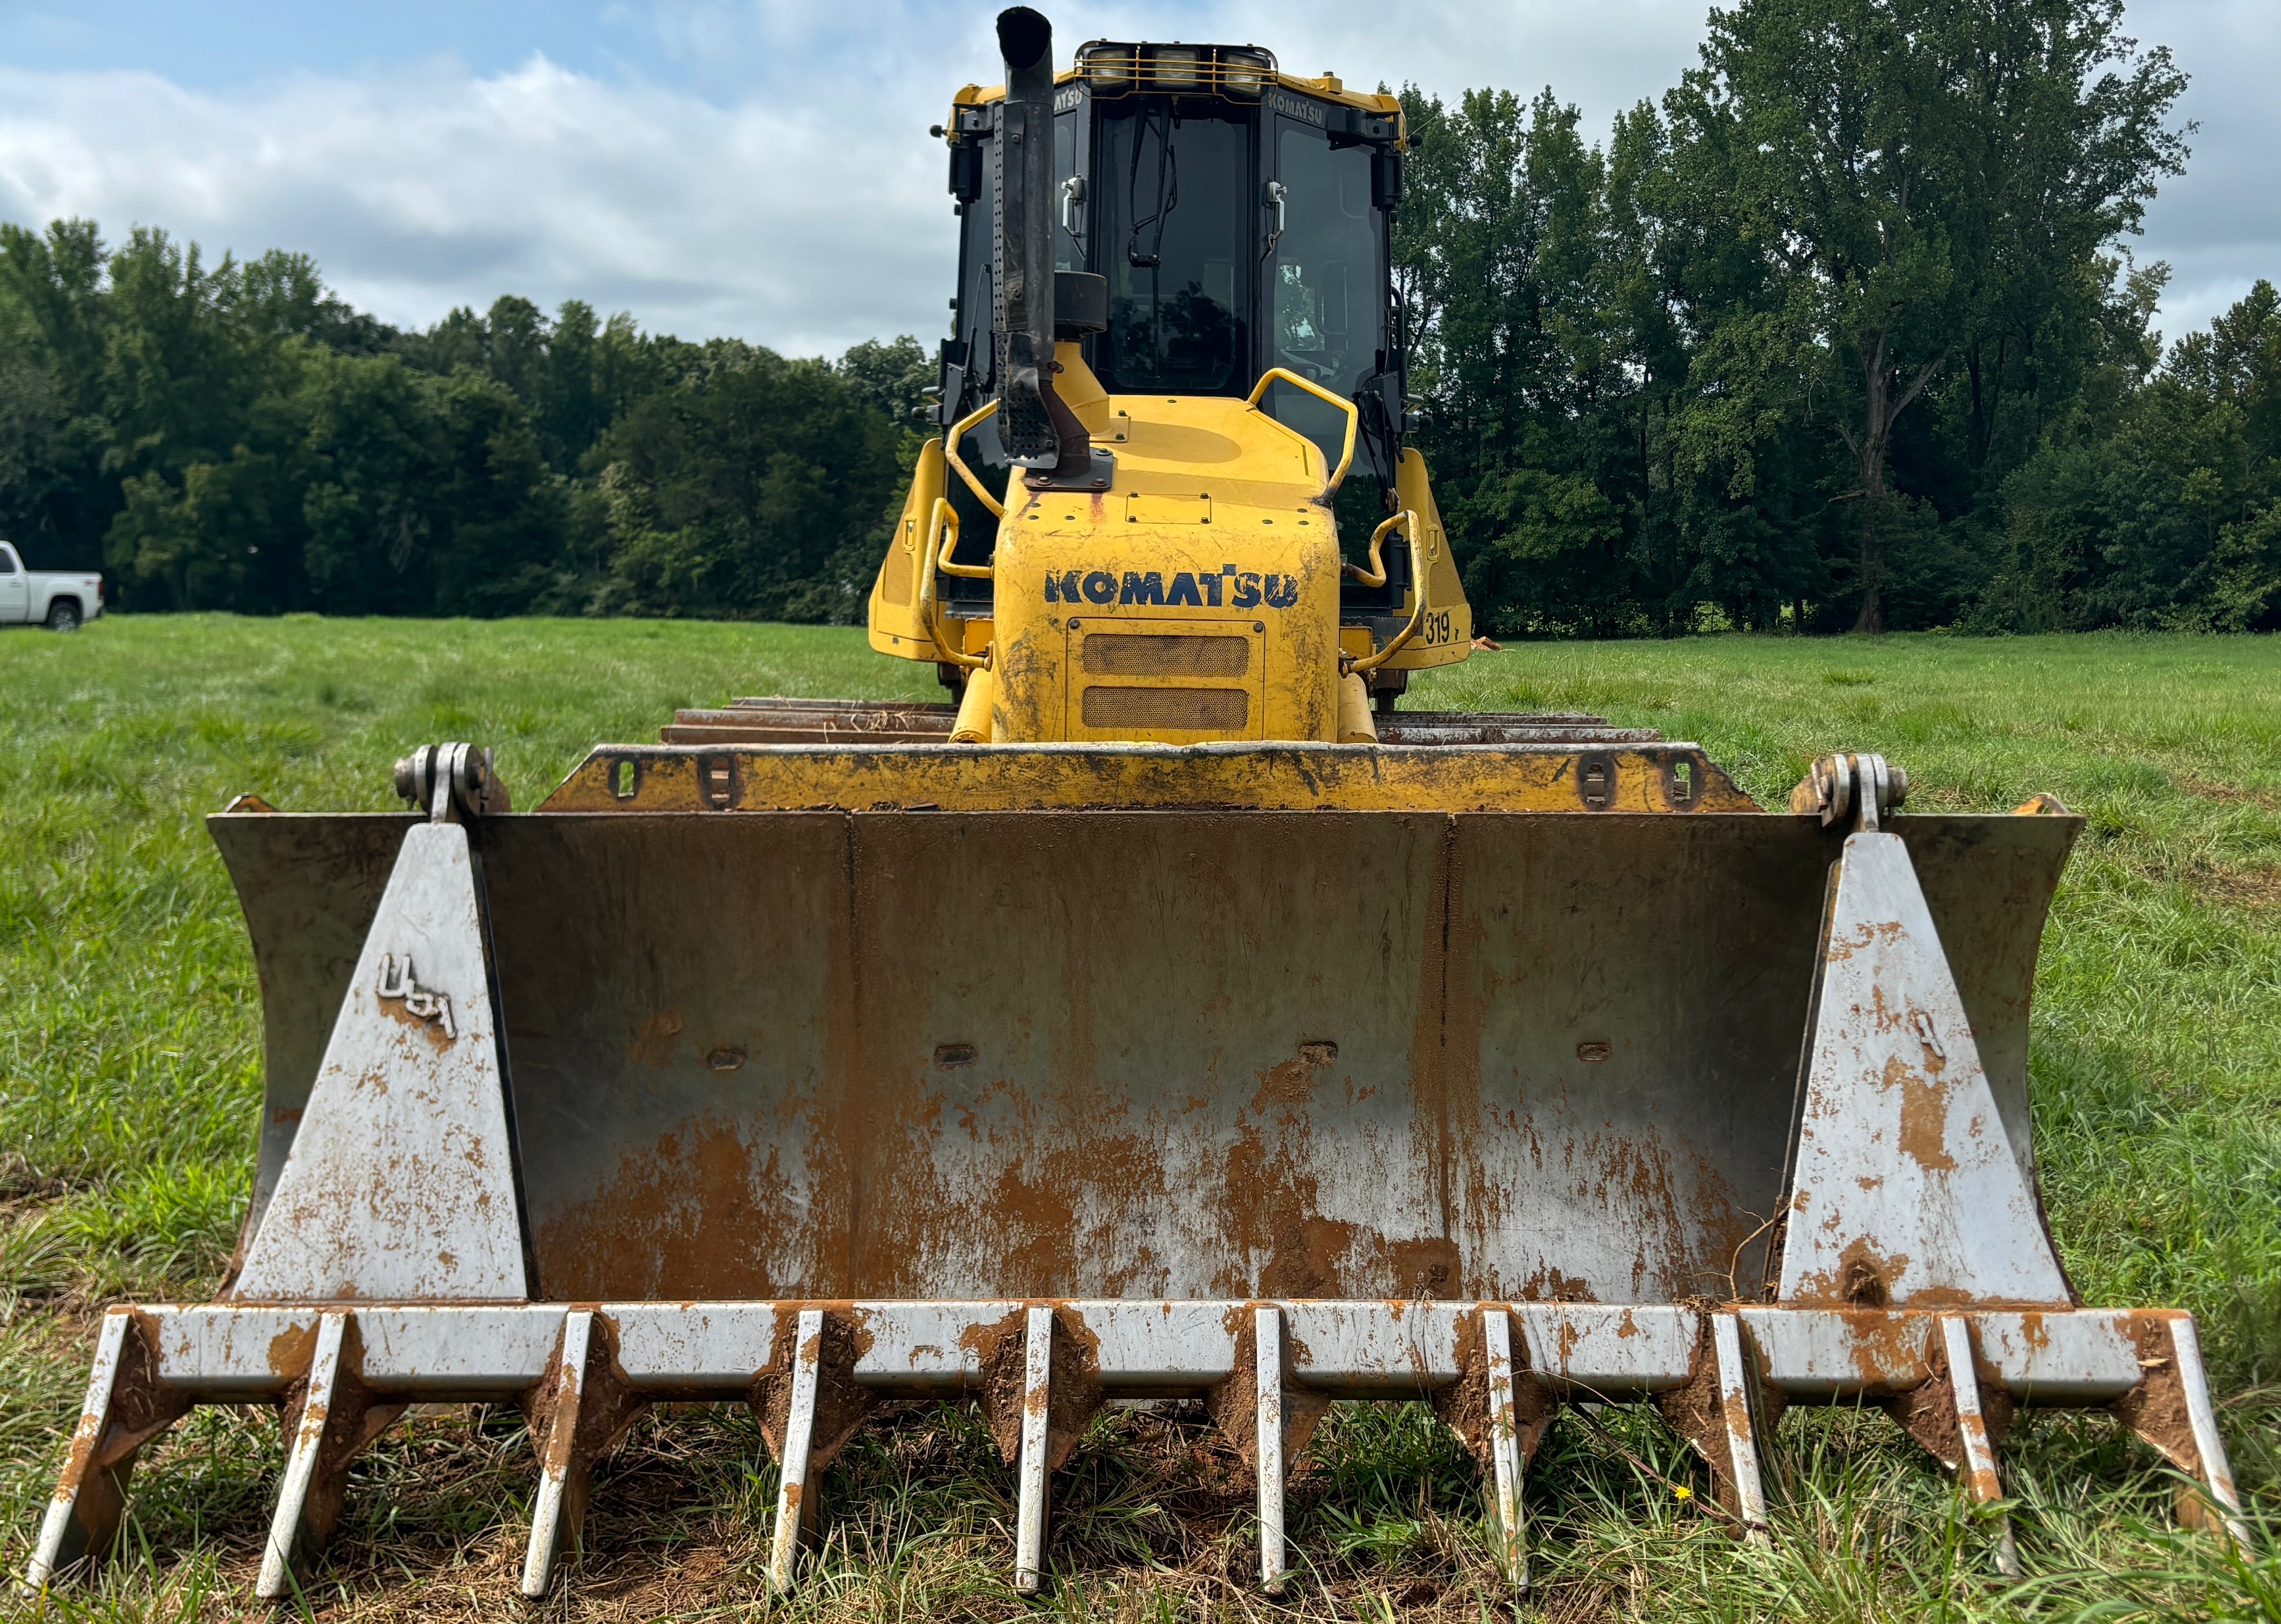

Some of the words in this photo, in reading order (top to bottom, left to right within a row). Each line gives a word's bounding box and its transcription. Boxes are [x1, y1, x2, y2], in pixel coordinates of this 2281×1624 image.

[1053, 88, 1083, 111] ATSU
[1268, 93, 1323, 124] KOMATSU
[1044, 564, 1298, 608] KOMATSU
[1425, 612, 1450, 644] 319
